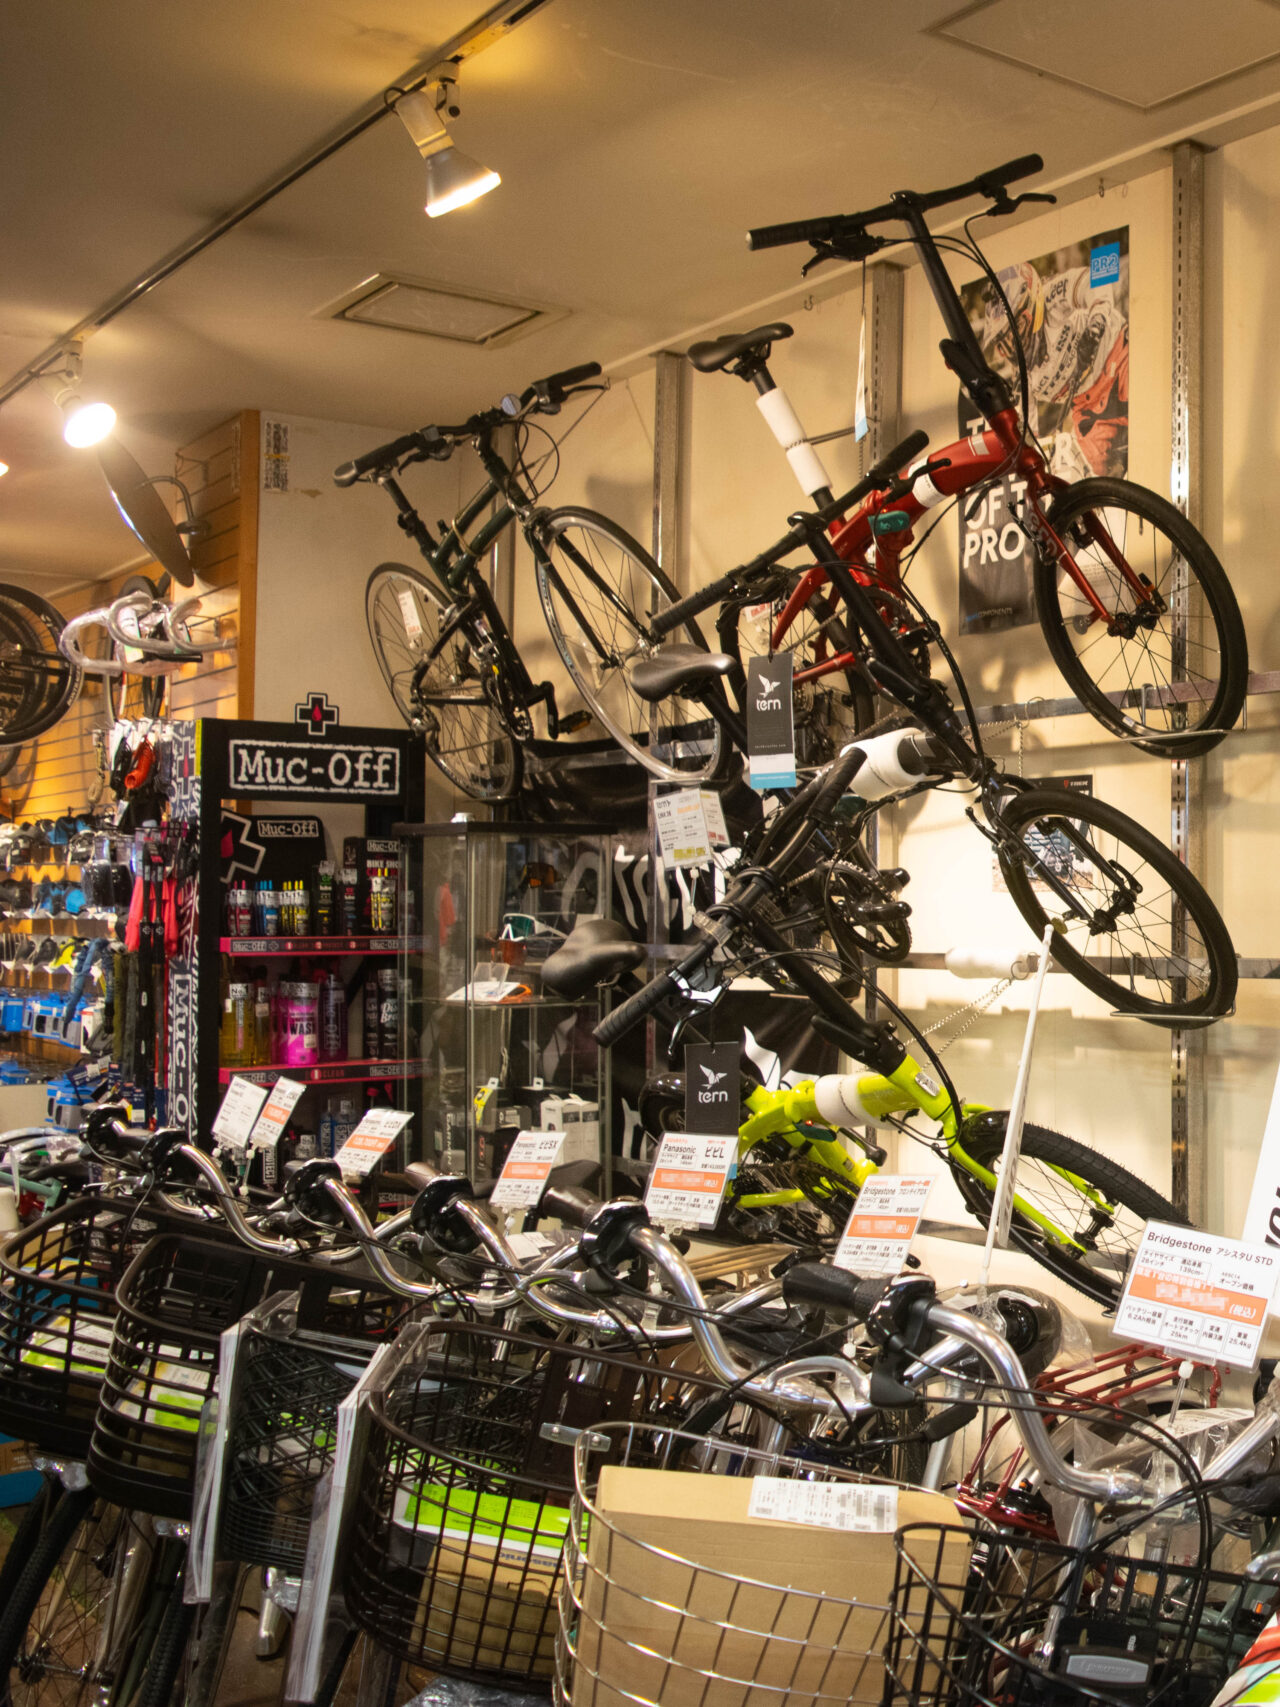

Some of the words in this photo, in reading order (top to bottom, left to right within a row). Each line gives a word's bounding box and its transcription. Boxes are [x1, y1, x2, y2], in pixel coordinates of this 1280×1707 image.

[963, 523, 1026, 569] PRO
[756, 698, 782, 711] tern
[237, 749, 394, 789] Muc-Off
[260, 822, 318, 836] Muc-Off
[698, 1090, 728, 1103] tern
[663, 1143, 697, 1154] Panasonic
[1147, 1231, 1212, 1255] Bridgestone
[1255, 1255, 1274, 1266] STD
